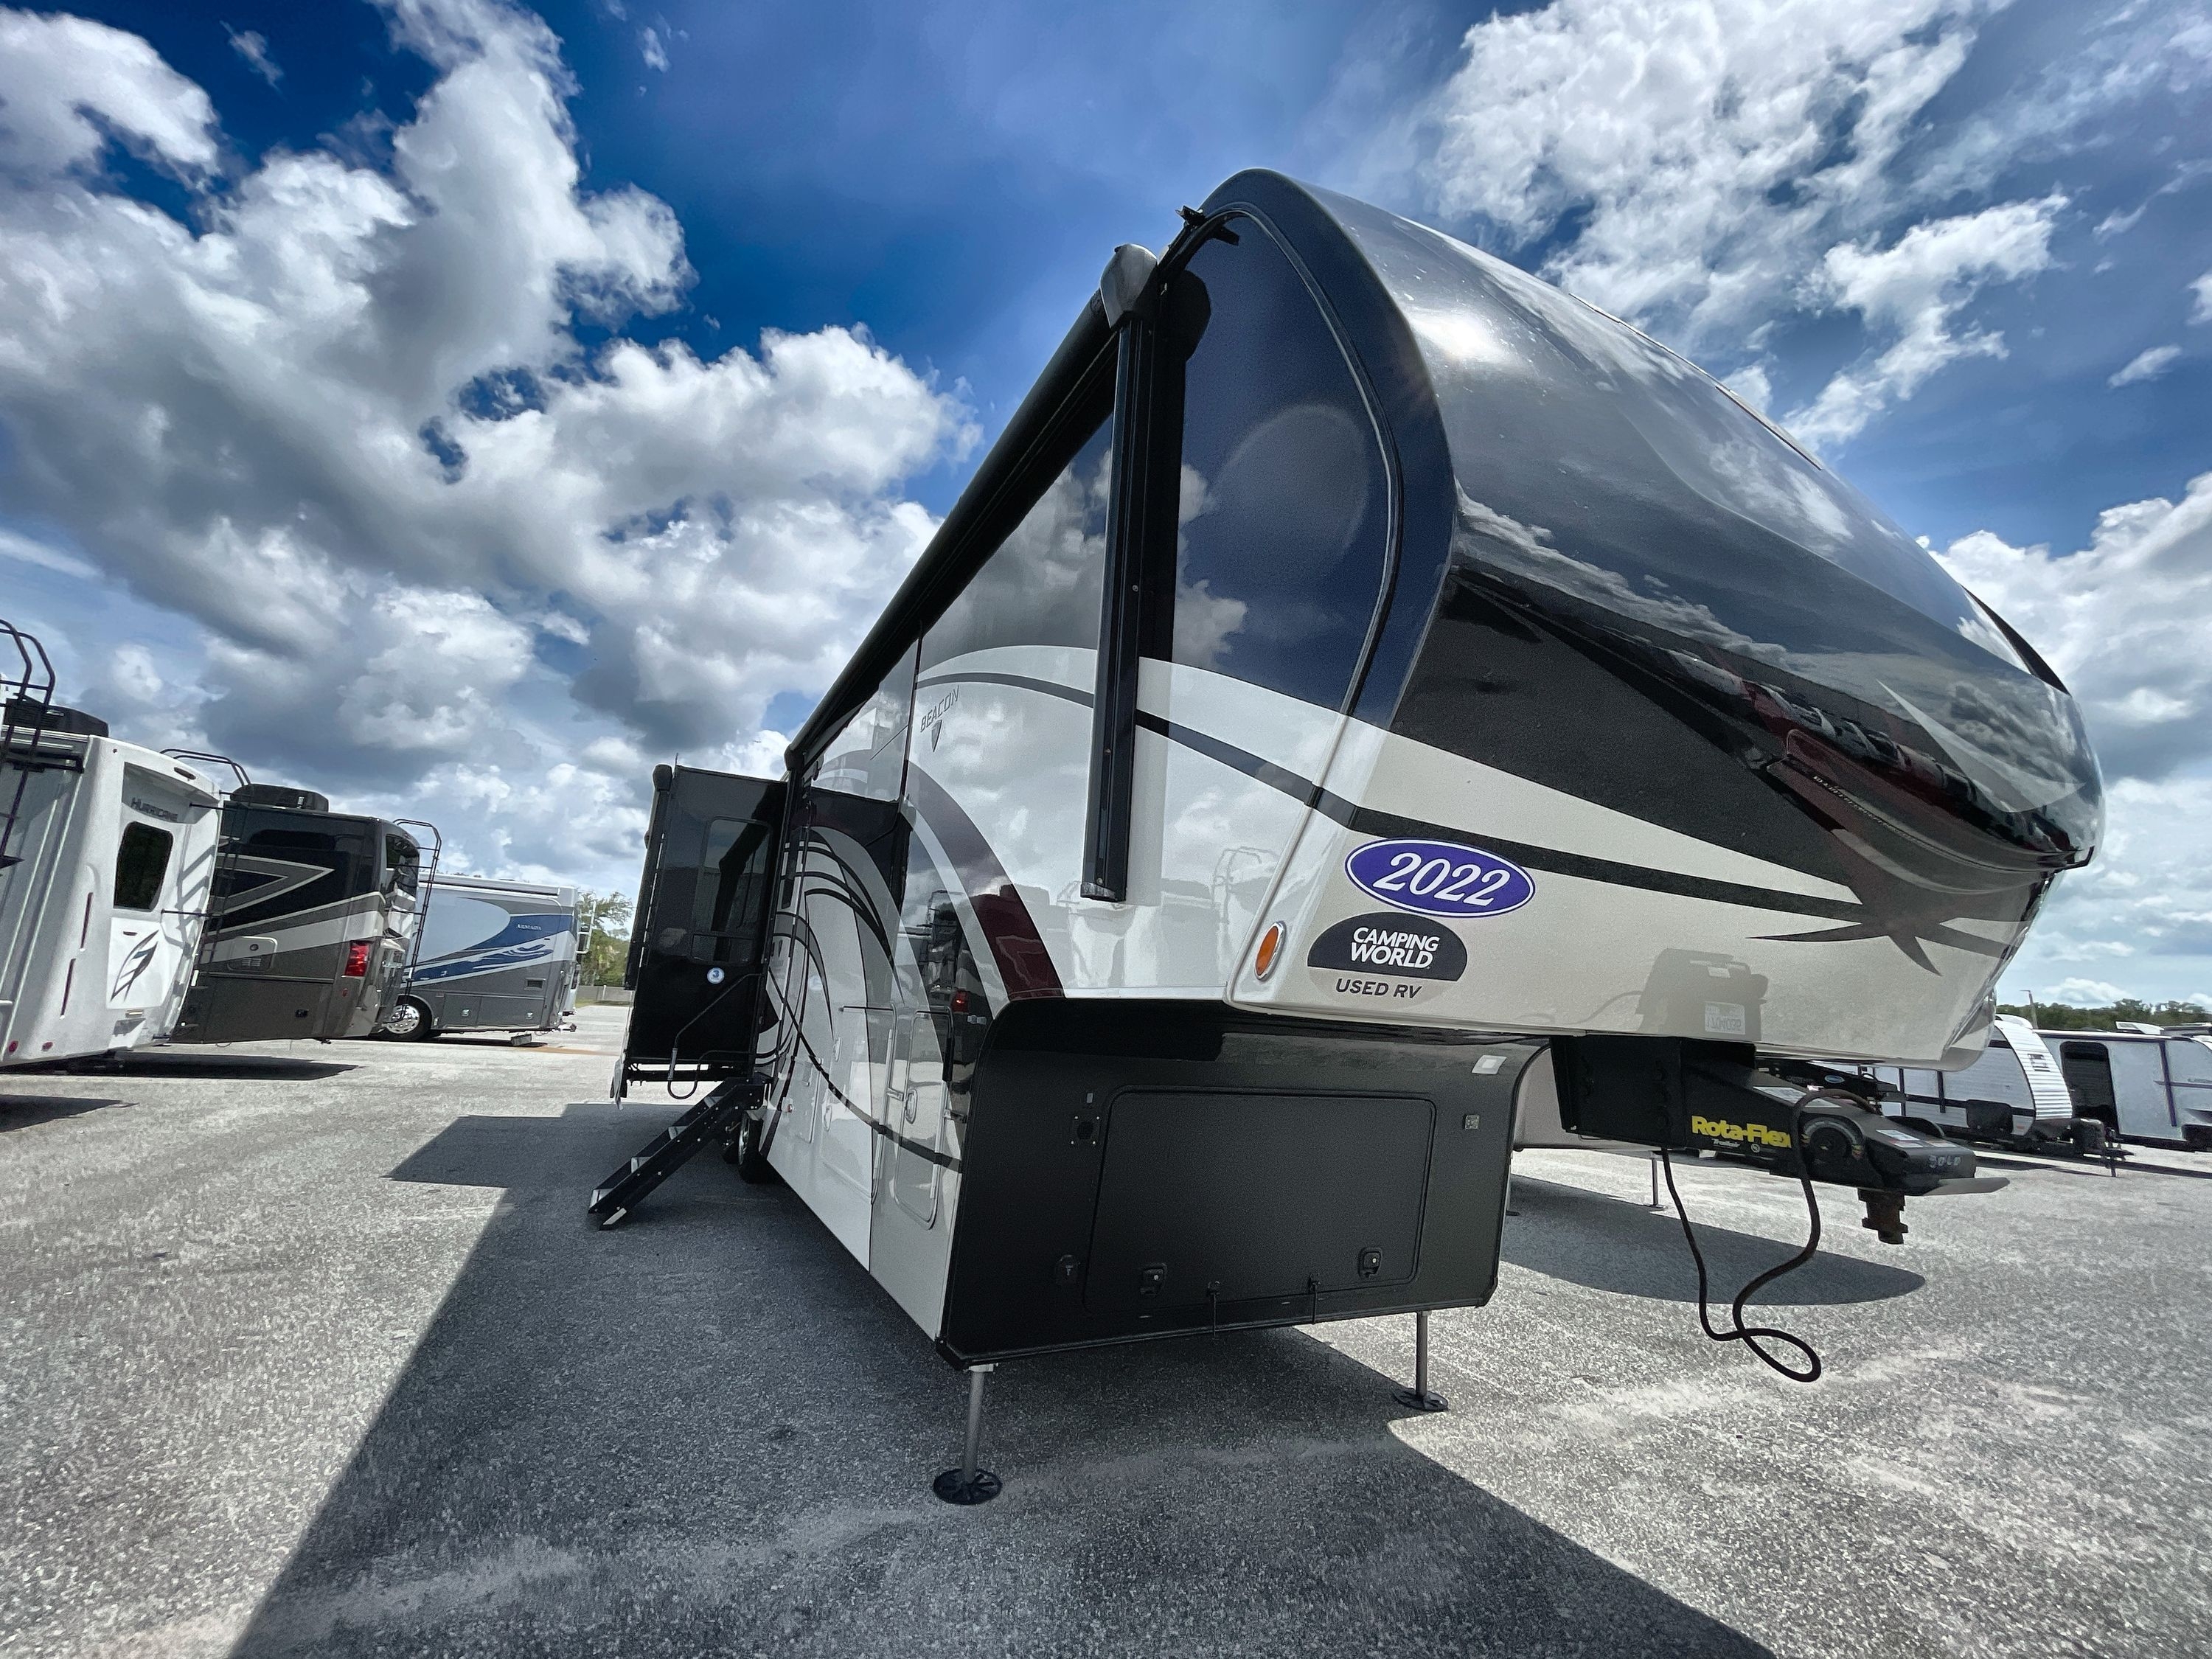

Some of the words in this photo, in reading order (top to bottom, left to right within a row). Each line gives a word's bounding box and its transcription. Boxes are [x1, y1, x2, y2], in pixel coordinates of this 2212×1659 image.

[920, 685, 959, 732] BEACON
[1372, 852, 1511, 906] 2022
[1353, 927, 1440, 952] CAMPING
[1350, 942, 1433, 969] WORLD
[1335, 978, 1389, 996] USED
[1393, 984, 1422, 999] RV
